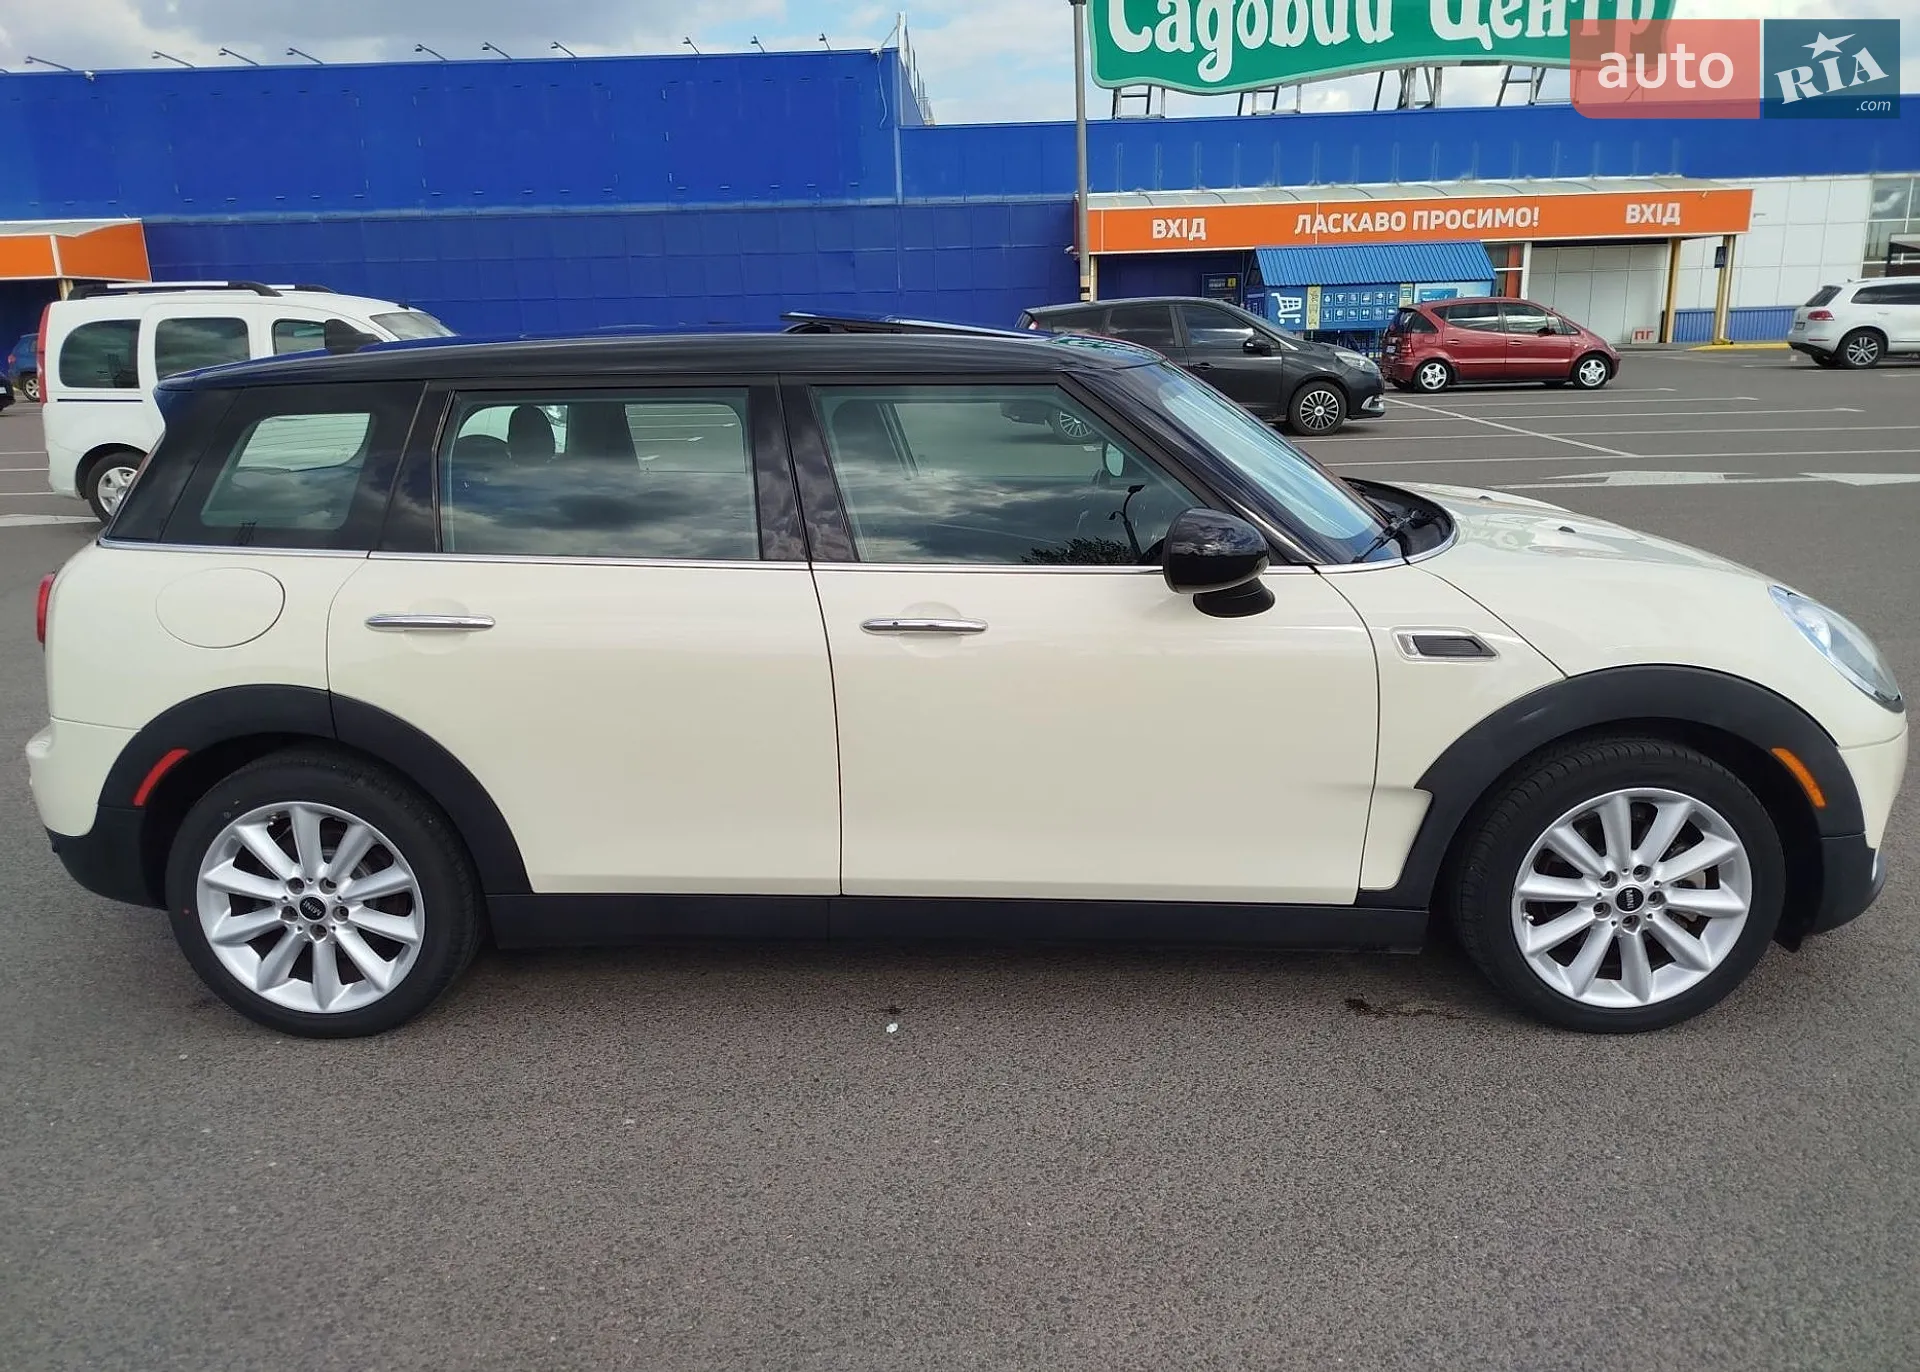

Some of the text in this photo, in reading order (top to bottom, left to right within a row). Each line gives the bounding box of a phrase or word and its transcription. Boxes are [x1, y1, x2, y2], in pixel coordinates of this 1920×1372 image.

[1294, 207, 1540, 235] ЛАСКАВО ПРОСИМО!
[1625, 203, 1681, 226] ВХІД
[1152, 218, 1207, 241] ВХІД
[1625, 889, 1634, 909] MINI
